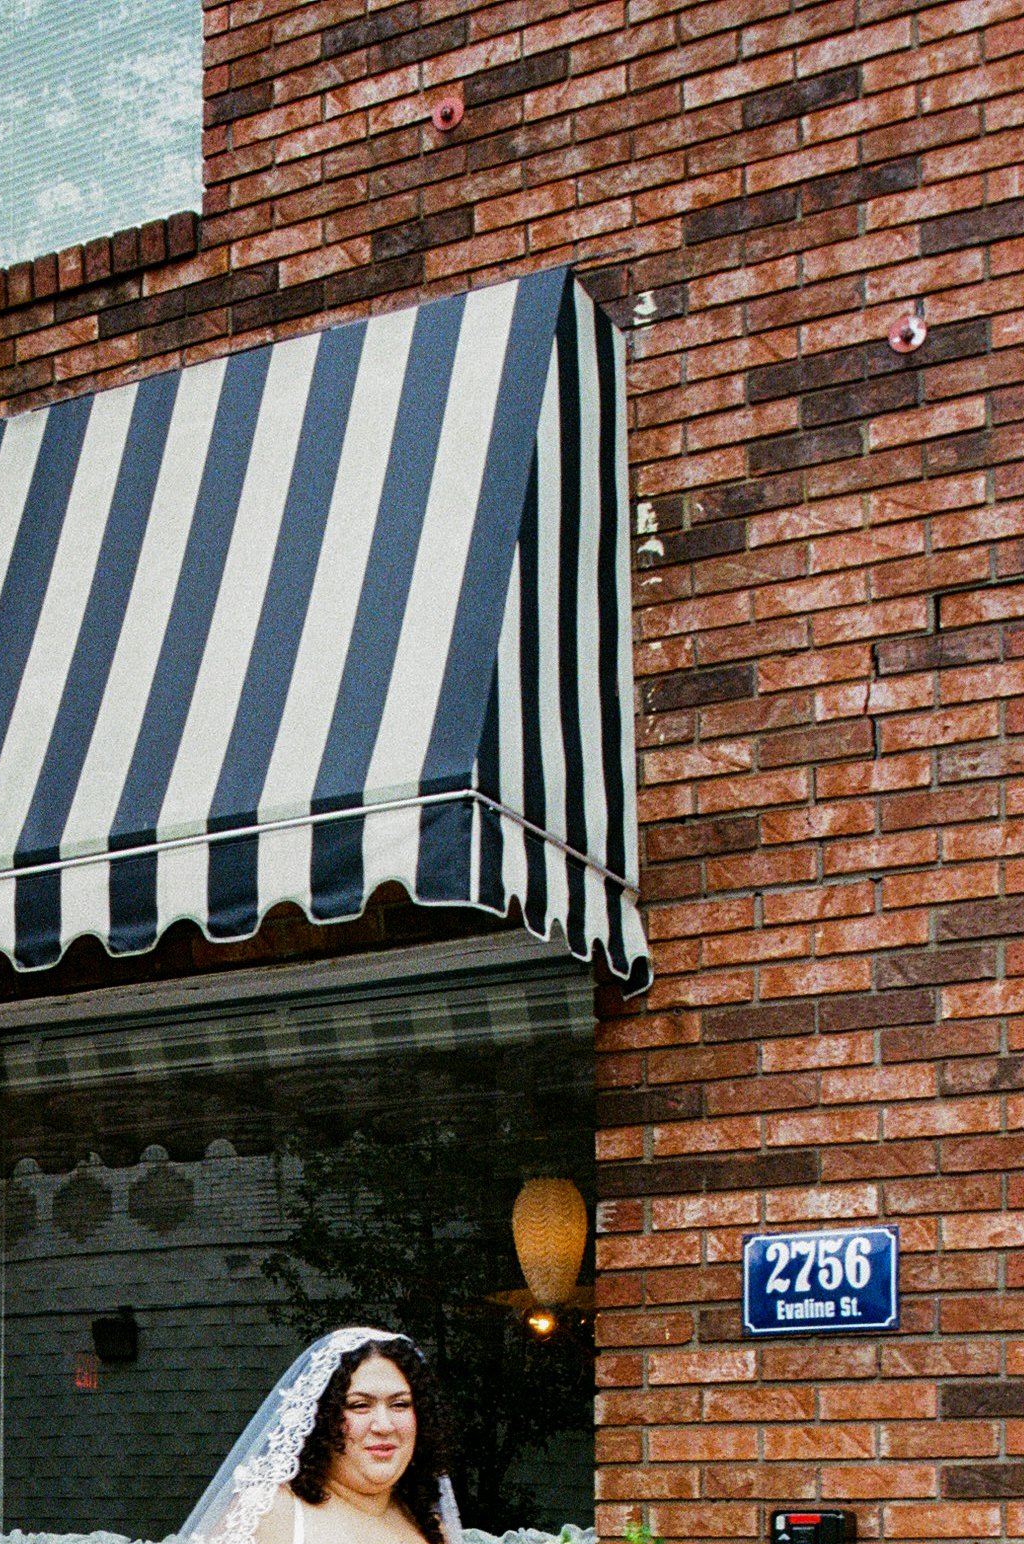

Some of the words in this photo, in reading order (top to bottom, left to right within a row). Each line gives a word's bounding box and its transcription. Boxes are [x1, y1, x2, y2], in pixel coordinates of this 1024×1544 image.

[765, 1237, 871, 1294] 2756
[777, 1298, 835, 1320] Evaline
[840, 1296, 862, 1317] St.
